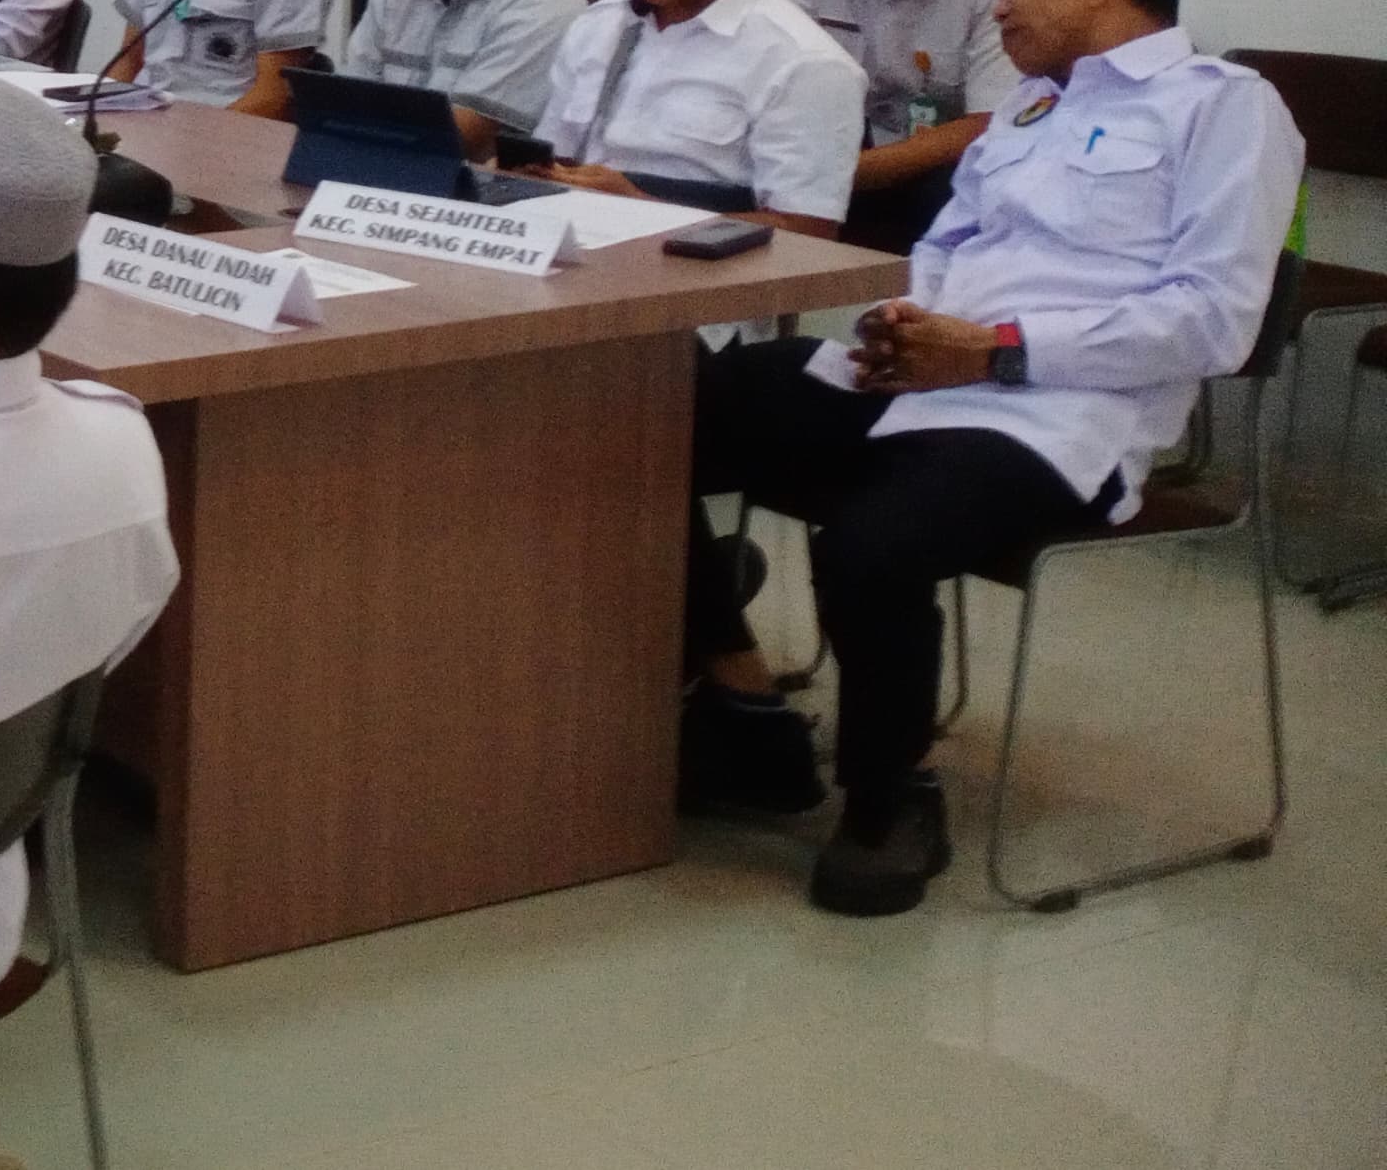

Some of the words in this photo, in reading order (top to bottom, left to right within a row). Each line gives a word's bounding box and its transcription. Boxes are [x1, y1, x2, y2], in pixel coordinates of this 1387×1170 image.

[309, 214, 356, 235] KEC.
[363, 222, 461, 252] SIMPANG
[464, 239, 543, 266] EMPAT
[345, 194, 399, 216] DESA
[405, 203, 527, 238] SEJAHTERA
[102, 227, 148, 252] DESA
[151, 239, 209, 269] DANAU
[213, 255, 276, 286] INDAH
[103, 259, 142, 285] KEC.
[147, 270, 242, 312] BATULICIN
